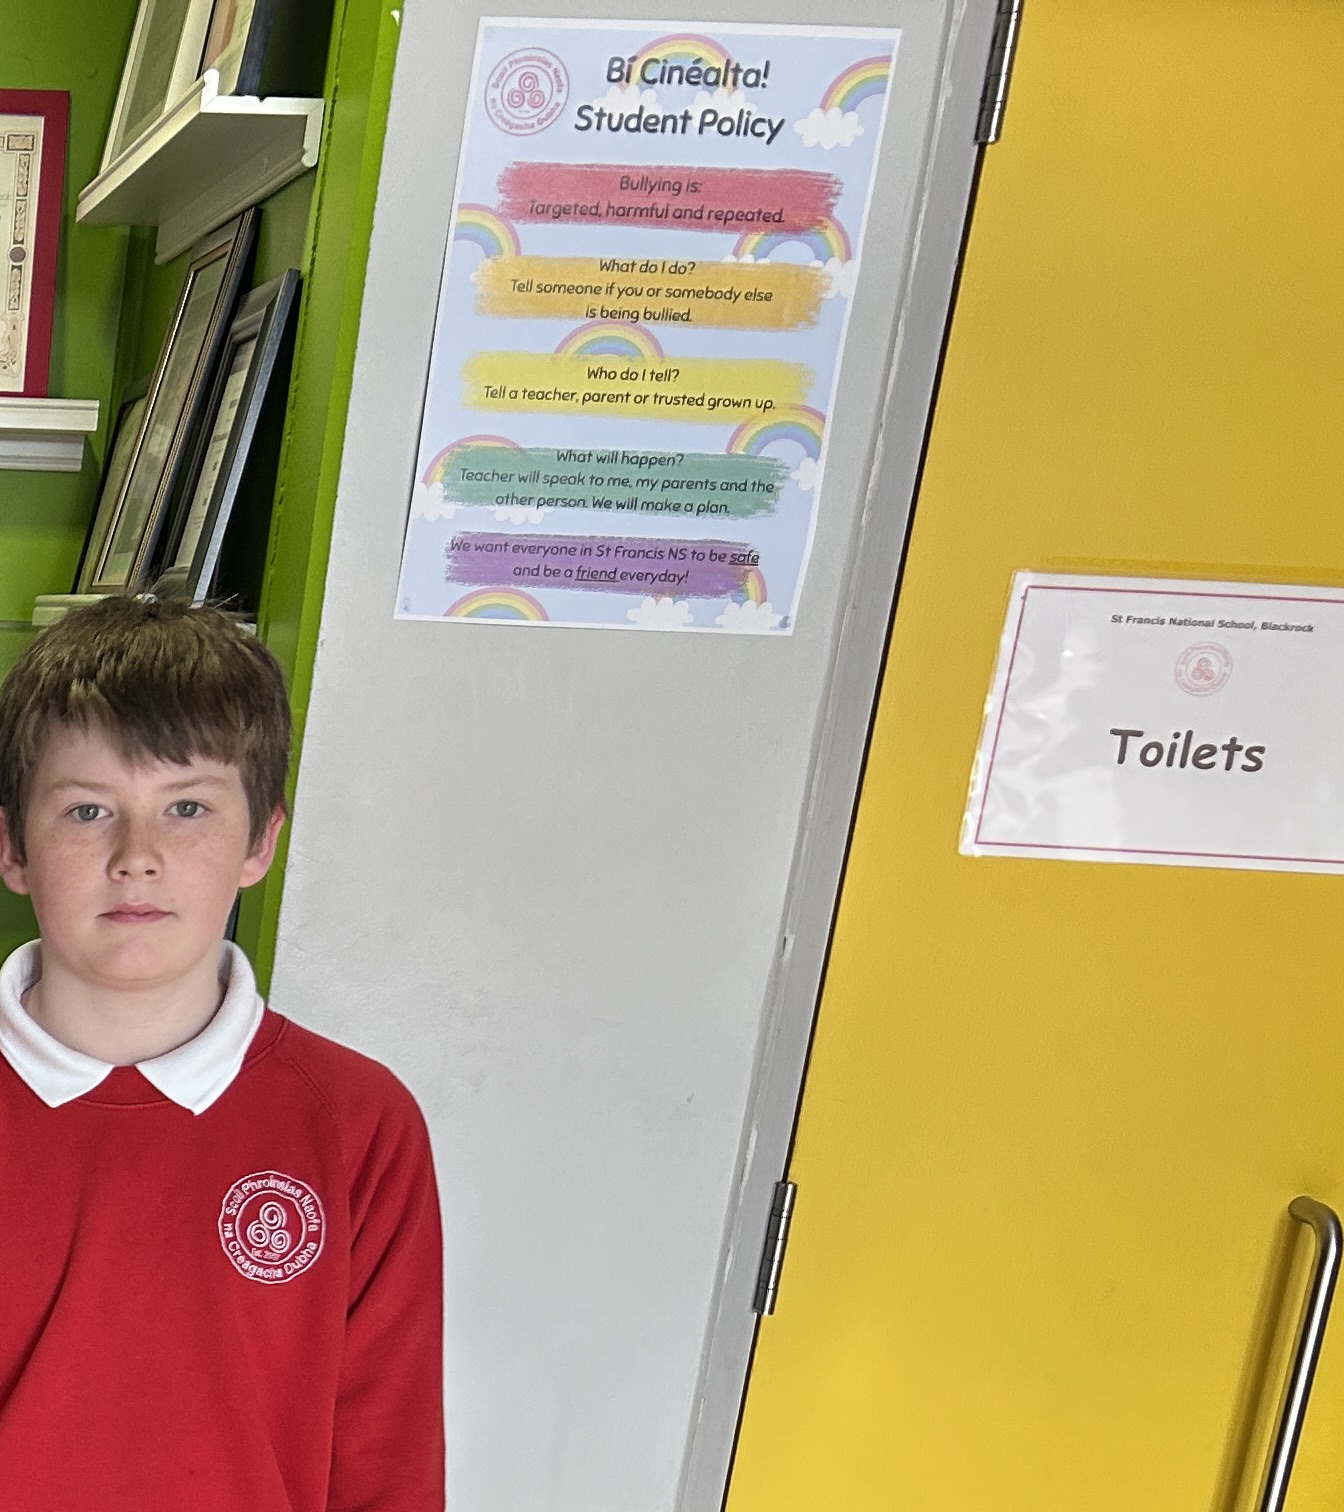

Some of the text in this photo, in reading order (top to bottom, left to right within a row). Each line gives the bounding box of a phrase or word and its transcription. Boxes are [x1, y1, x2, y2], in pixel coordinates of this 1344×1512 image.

[606, 54, 771, 94] Bí Cinéalta!
[574, 104, 787, 146] Student Policy
[619, 175, 704, 197] Bullying is:
[529, 199, 786, 227] Targeted, harmful and repeated.
[599, 258, 697, 276] What do I do?
[510, 278, 774, 305] Tell someone if you or somebody else
[585, 304, 694, 324] is being bullied.
[587, 365, 680, 383] Who do I tell?
[483, 384, 777, 414] Tell a teacher, parent or trusted grown up.
[556, 448, 685, 470] What will happen?
[459, 467, 777, 496] Teacher will speak to me, my parents and the
[495, 491, 731, 517] other person. We will make a plan.
[450, 540, 761, 567] We want everyone in St Francis NS to be safe
[512, 563, 690, 587] and be a friend everyday!
[1111, 615, 1314, 632] St Francis National School, Blackrock
[1110, 728, 1266, 772] Toilets
